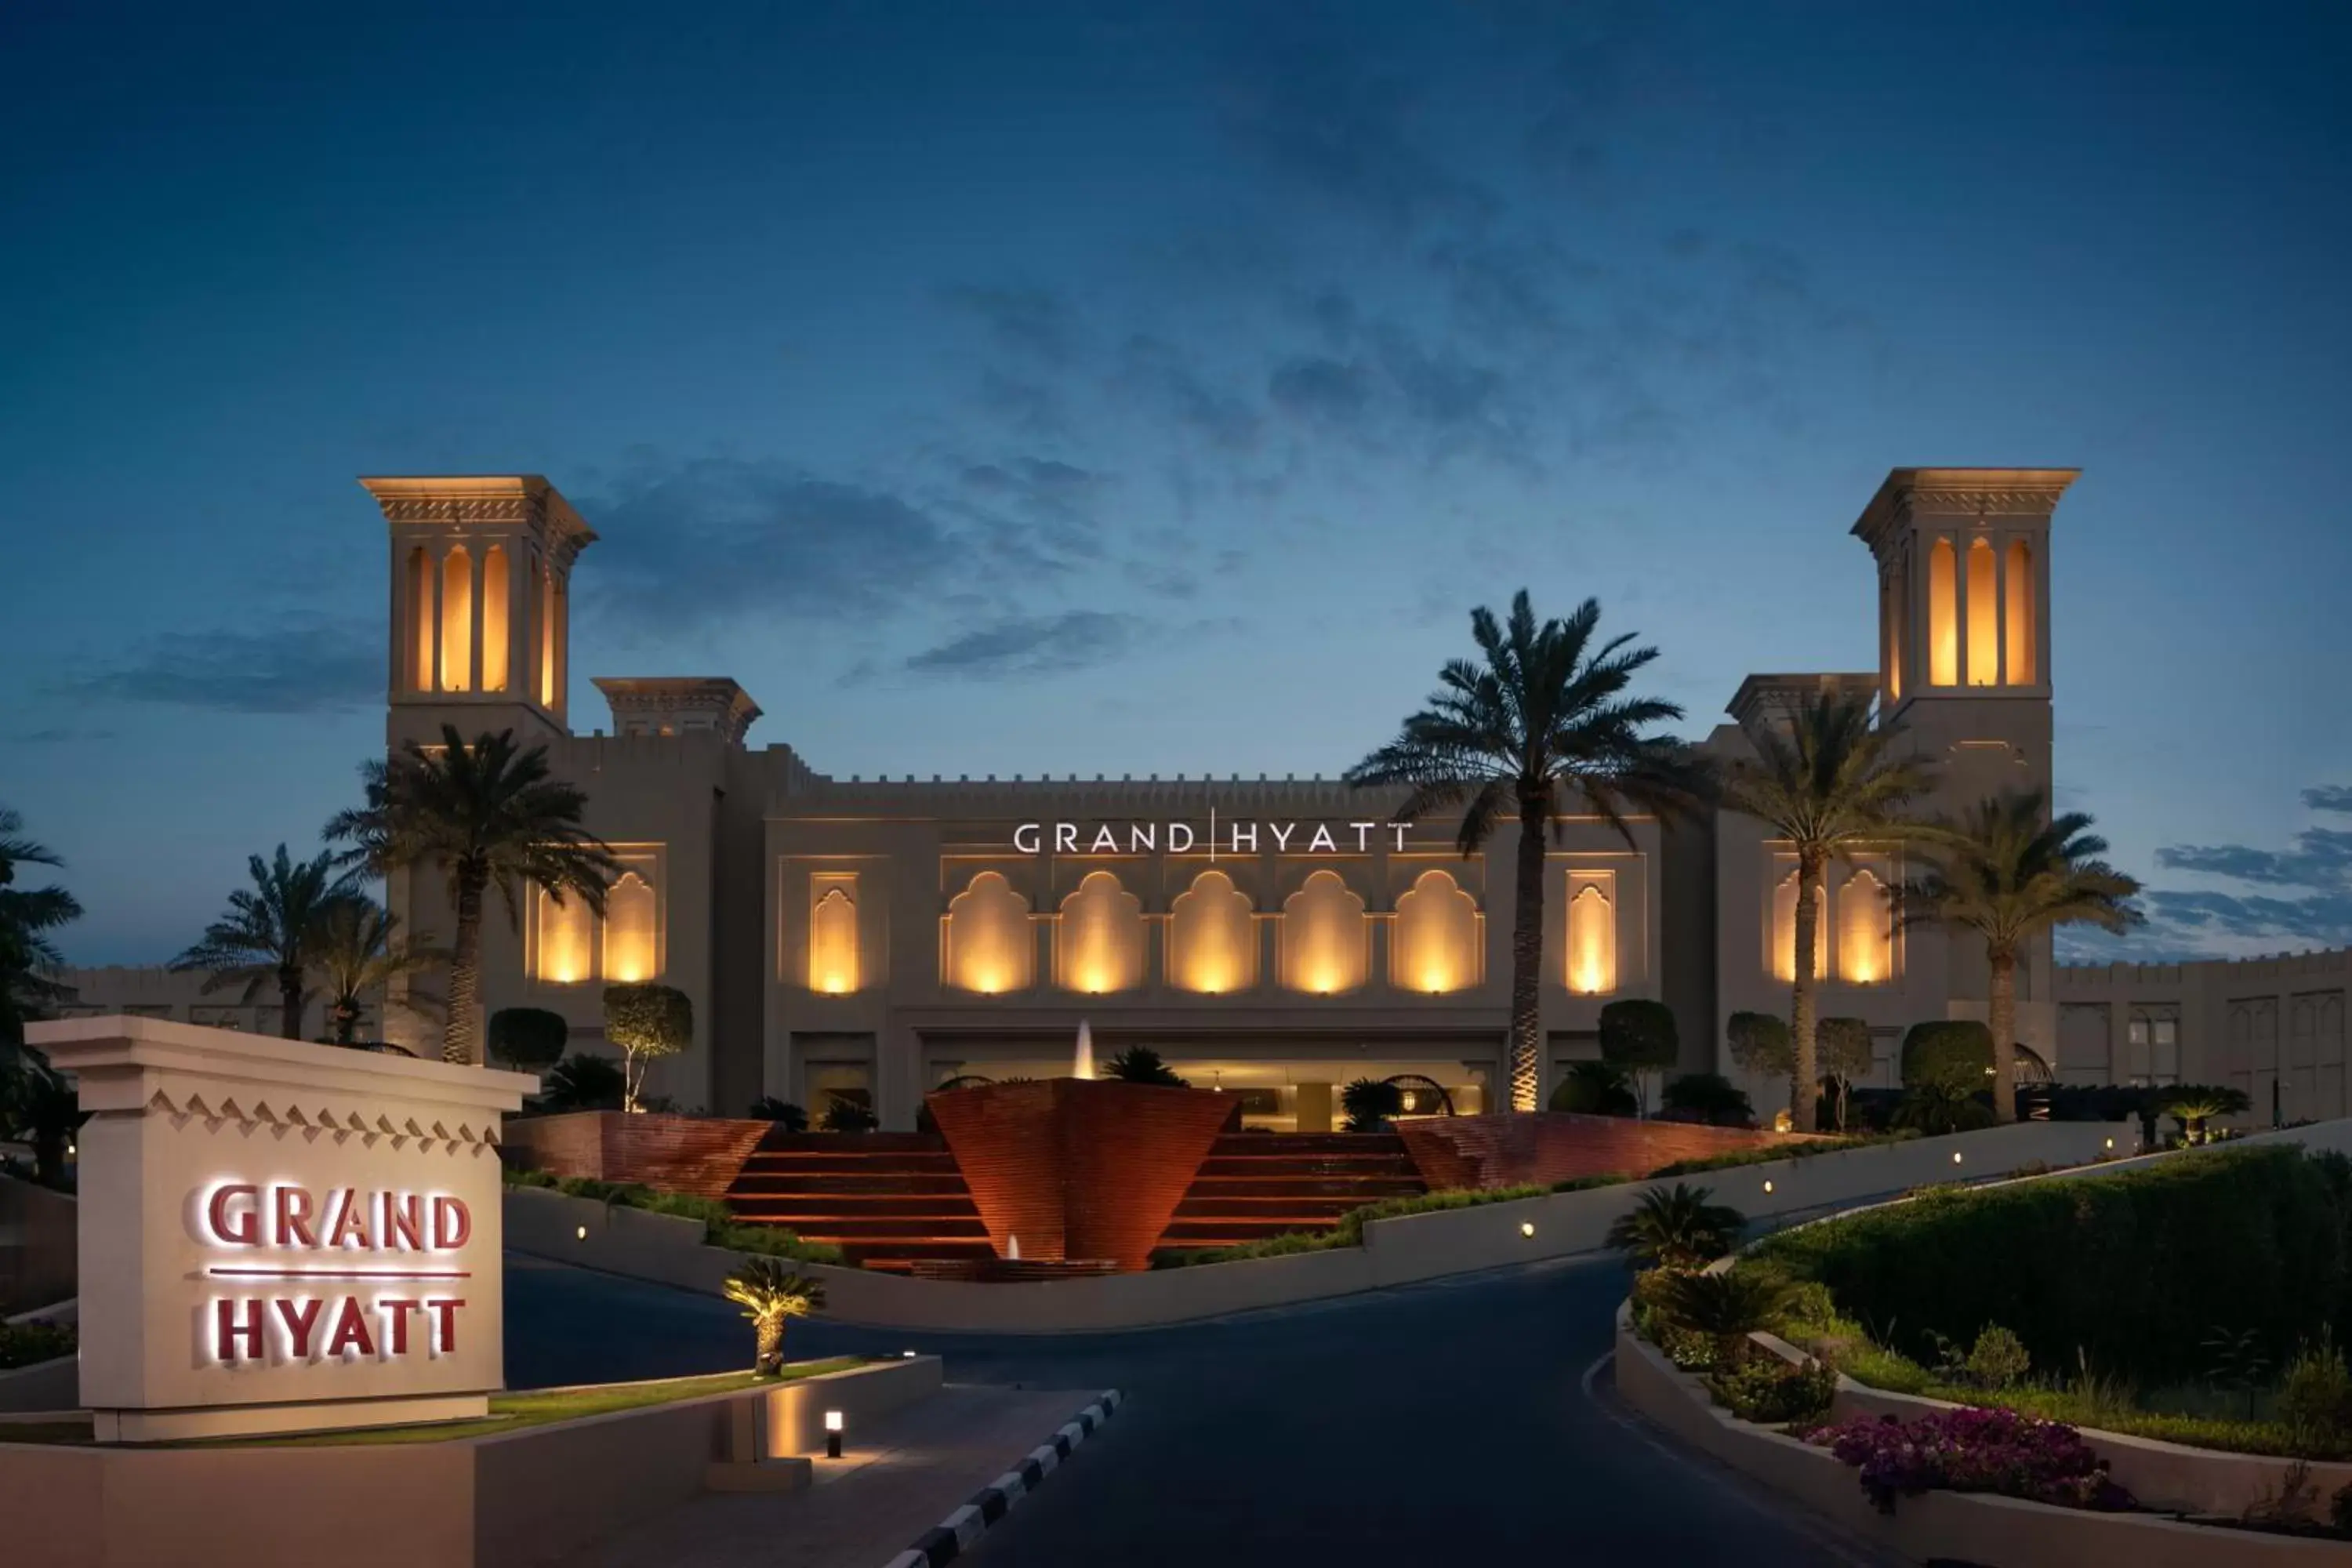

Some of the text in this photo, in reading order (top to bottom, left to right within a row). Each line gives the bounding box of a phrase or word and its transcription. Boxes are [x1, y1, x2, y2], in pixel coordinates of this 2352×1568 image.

[1014, 822, 1413, 853] GRAND HYATT
[209, 1184, 470, 1250] GRAND
[217, 1296, 466, 1359] HYATT
